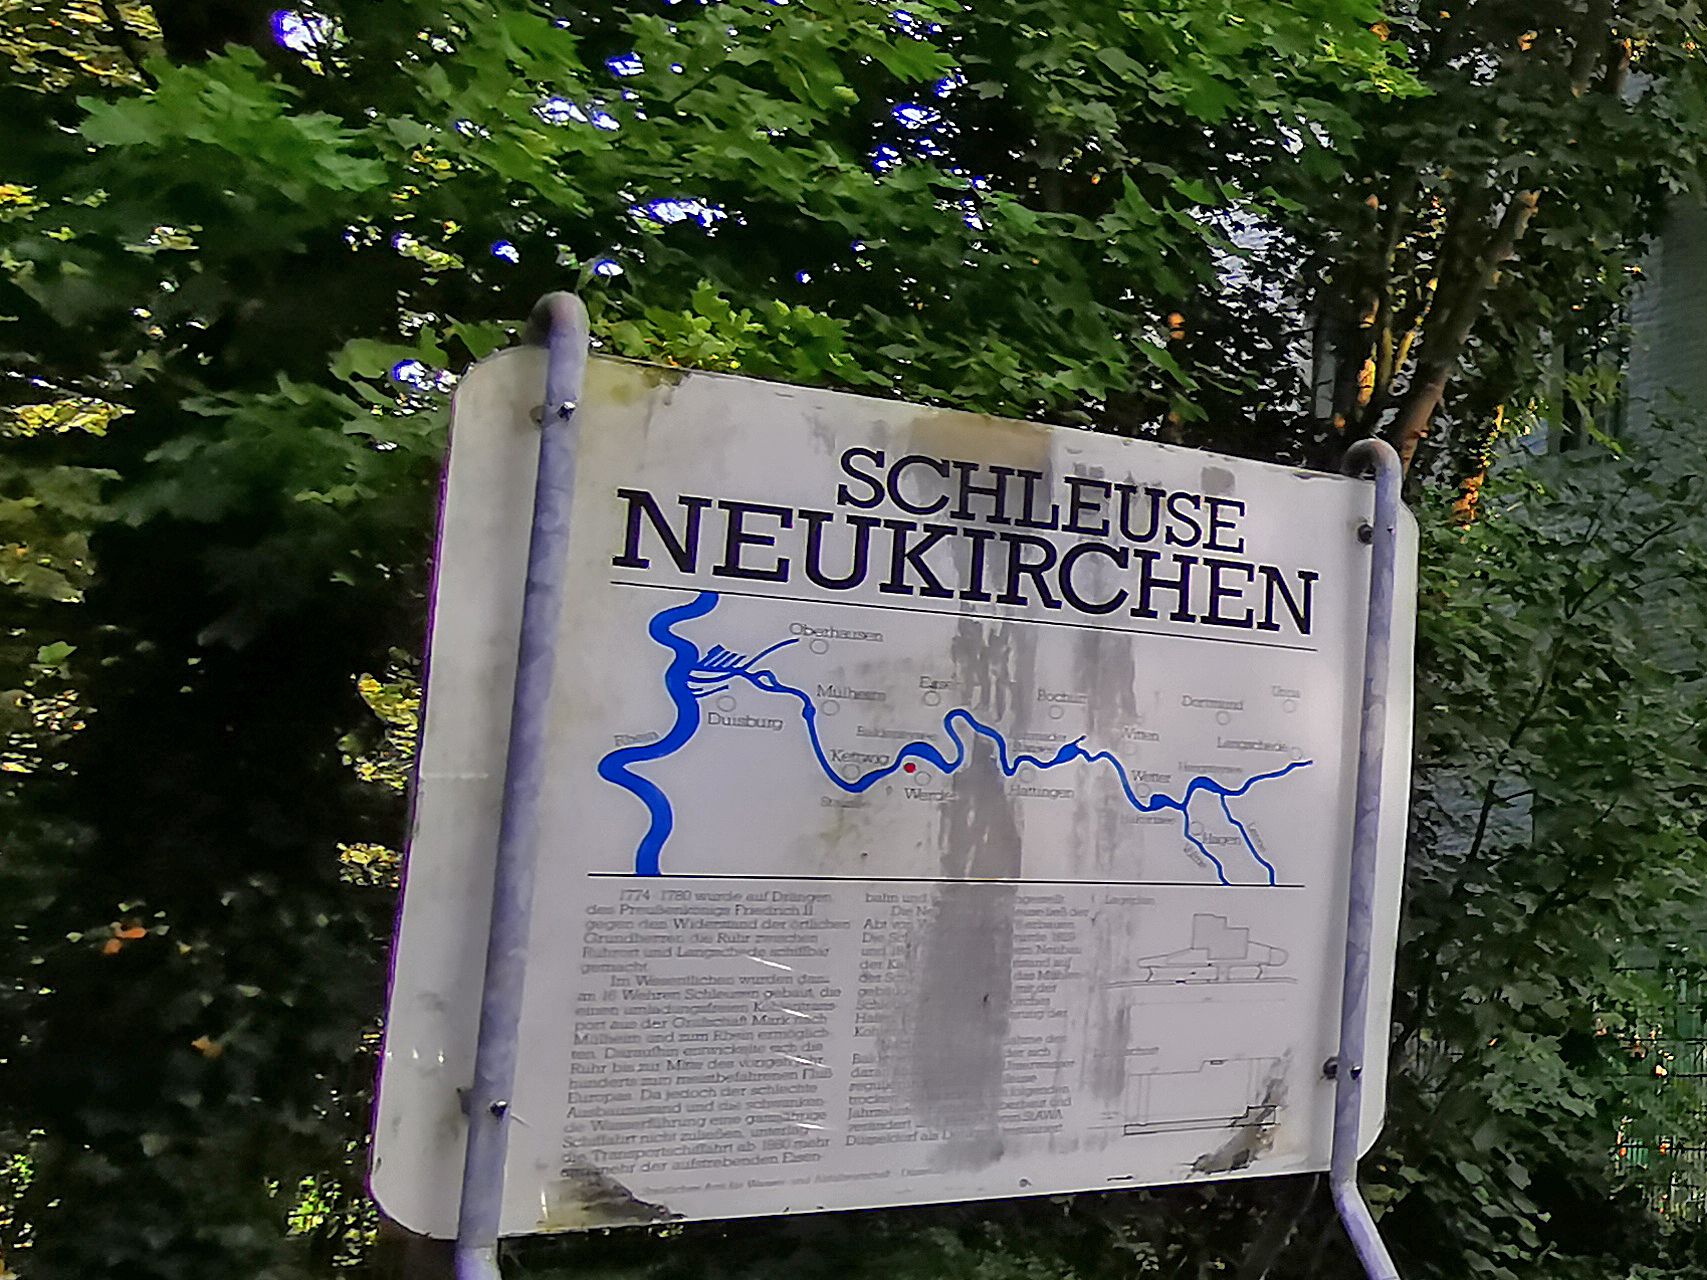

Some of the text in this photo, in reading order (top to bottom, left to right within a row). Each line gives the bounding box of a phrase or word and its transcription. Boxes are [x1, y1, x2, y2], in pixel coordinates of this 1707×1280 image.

[837, 446, 1246, 553] SCHLEUSE
[611, 487, 1320, 636] NEUKIRCHEN
[707, 712, 783, 731] Duisburg
